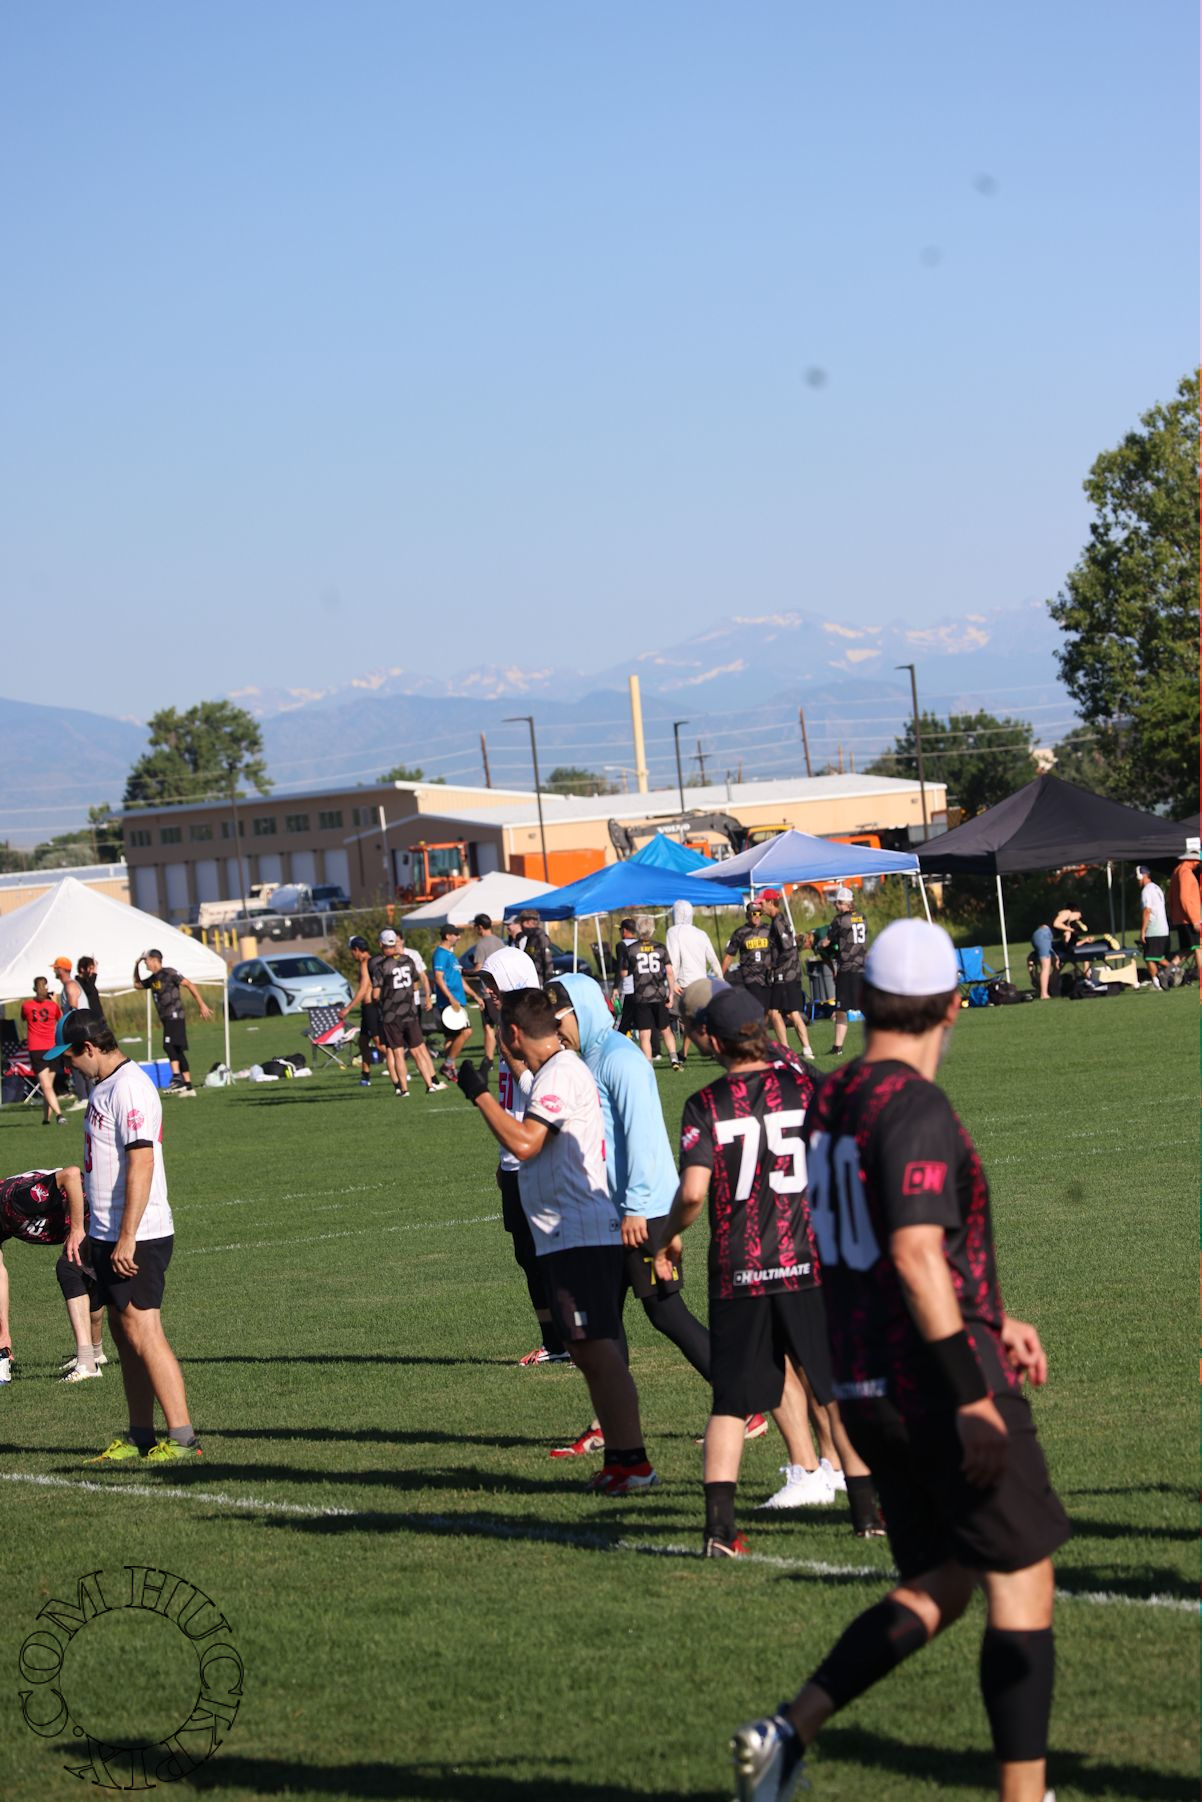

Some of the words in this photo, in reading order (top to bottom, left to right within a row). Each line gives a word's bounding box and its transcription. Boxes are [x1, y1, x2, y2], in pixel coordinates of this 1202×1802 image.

[852, 923, 865, 944] 13
[636, 952, 661, 974] 26
[755, 951, 761, 962] 9
[392, 966, 411, 990] 25
[716, 1109, 807, 1201] 75
[752, 1263, 809, 1283] ULTIMATE
